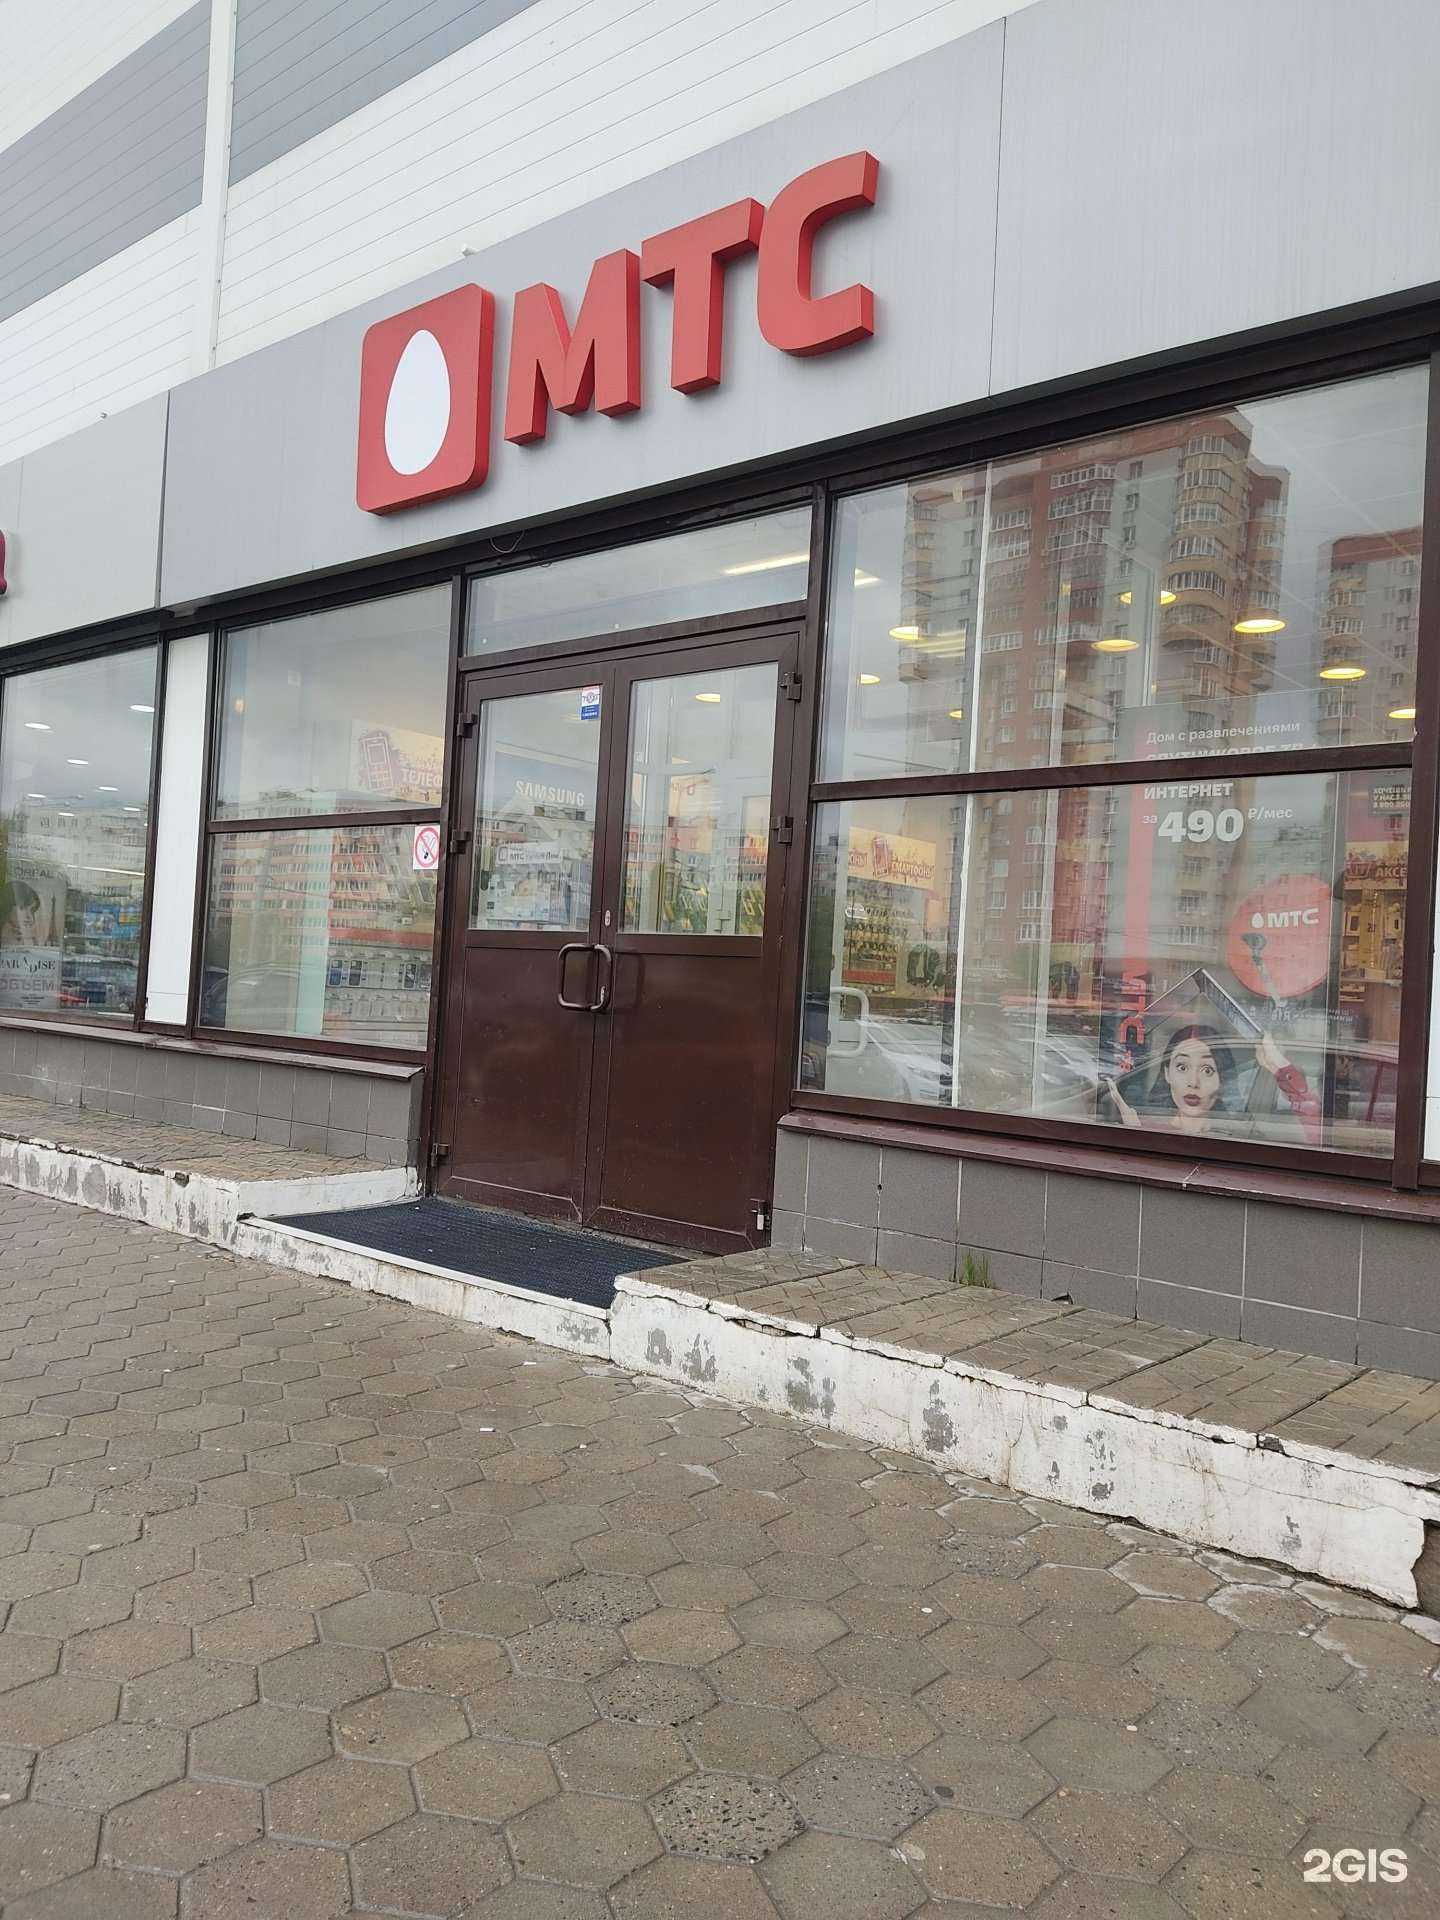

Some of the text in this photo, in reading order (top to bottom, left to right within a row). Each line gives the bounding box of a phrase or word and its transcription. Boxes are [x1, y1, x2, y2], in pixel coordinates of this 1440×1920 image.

[504, 150, 880, 446] МТС
[1147, 722, 1301, 745] Дом с развлечениями
[515, 780, 585, 807] SAMSUNG
[1144, 782, 1234, 800] ИНТЕРНЕТ
[1143, 815, 1158, 825] за
[1158, 808, 1244, 843] 490
[1266, 907, 1320, 929] МТС
